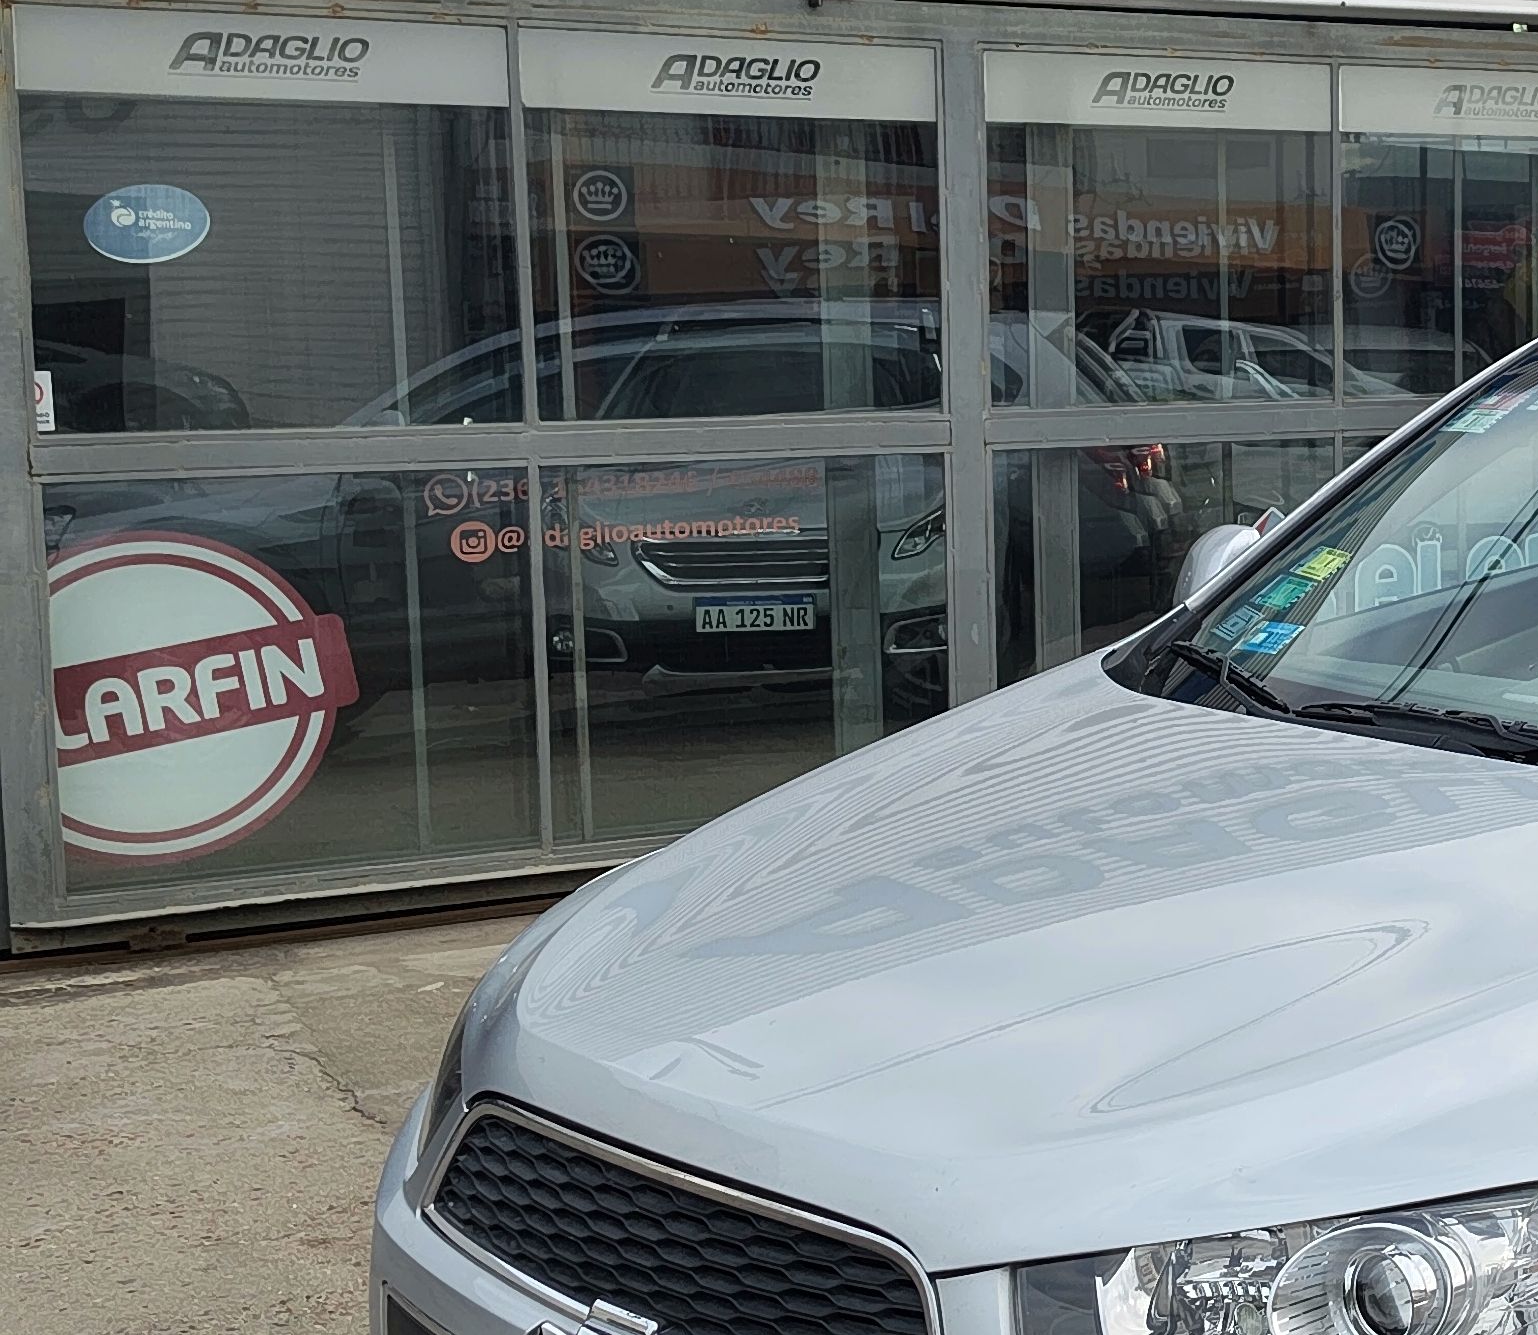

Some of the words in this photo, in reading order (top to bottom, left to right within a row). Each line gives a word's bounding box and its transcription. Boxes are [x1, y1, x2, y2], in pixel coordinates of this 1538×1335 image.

[168, 31, 370, 71] ADAGLIO
[219, 60, 361, 78] automotores
[651, 54, 821, 90] ADAGLIO
[693, 79, 812, 96] automotores
[1092, 71, 1234, 104] ADAGLIO
[1127, 94, 1227, 108] automotores
[139, 219, 191, 230] argentino
[702, 608, 727, 629] AA
[736, 607, 774, 628] 125
[783, 606, 808, 627] NR
